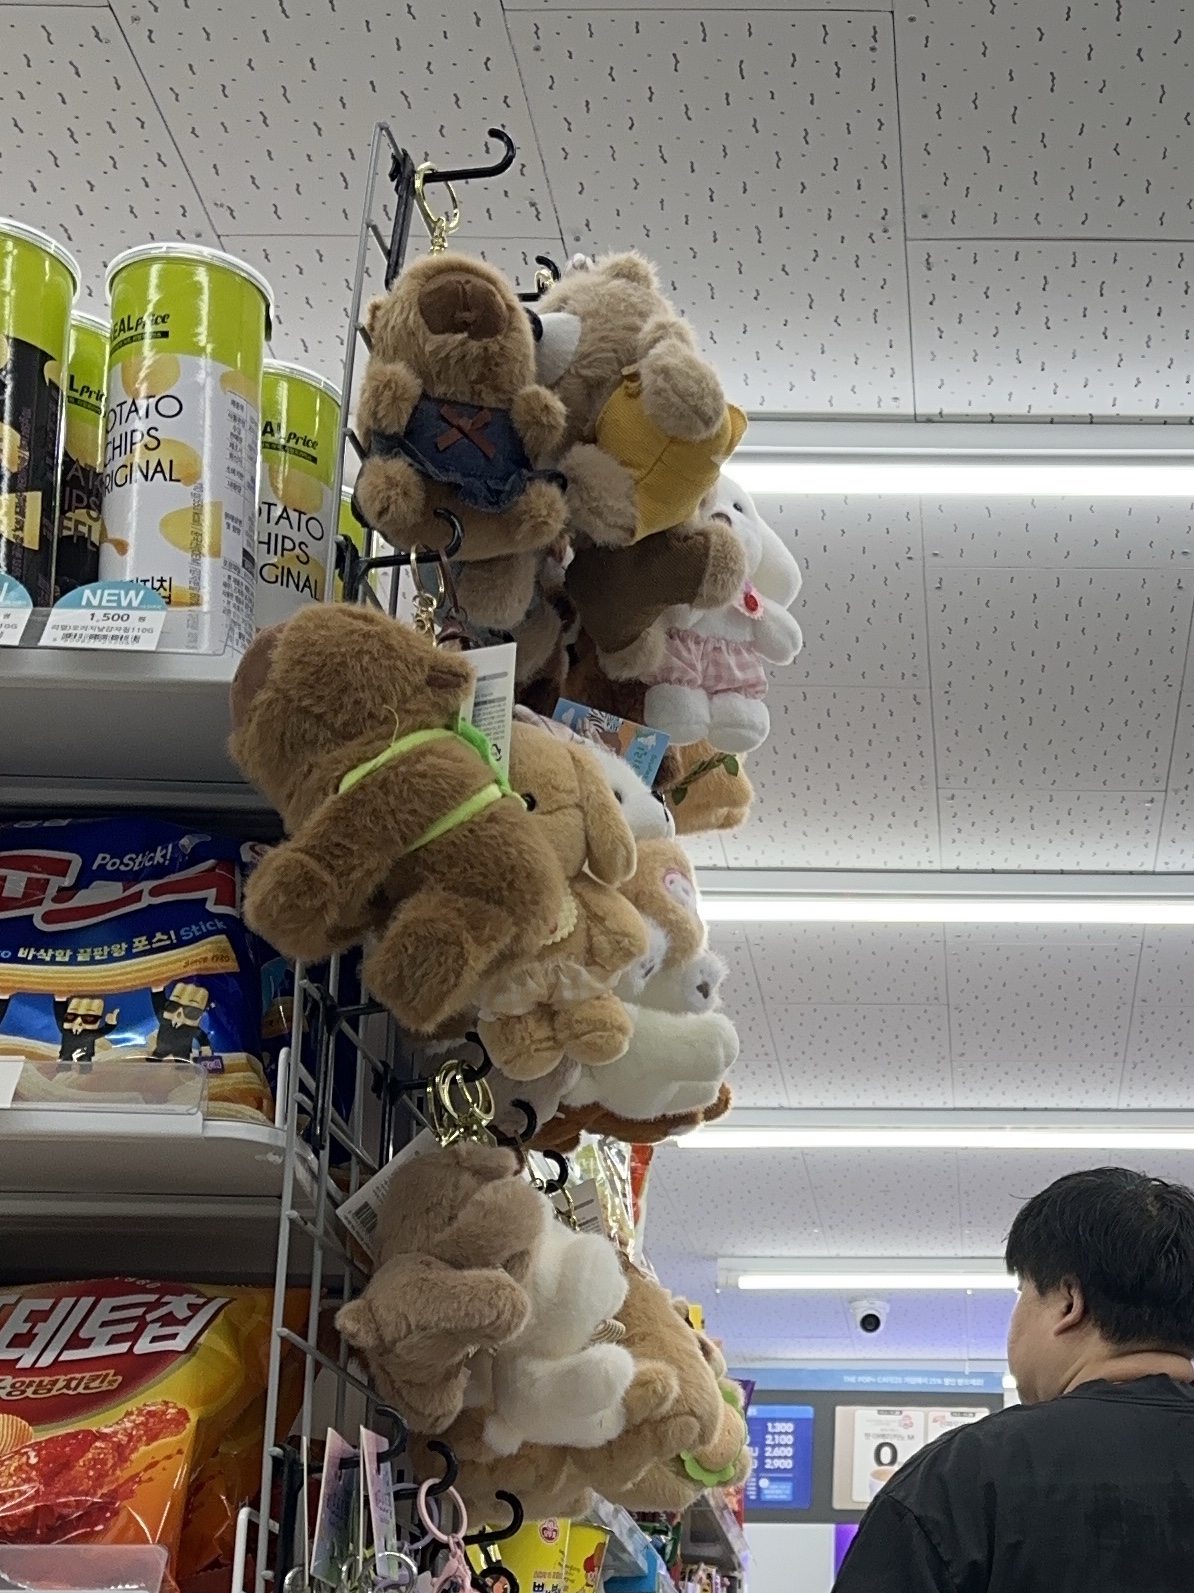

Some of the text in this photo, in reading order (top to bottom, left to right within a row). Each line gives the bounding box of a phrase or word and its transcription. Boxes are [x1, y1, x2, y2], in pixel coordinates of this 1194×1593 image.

[106, 394, 183, 434] OTATO
[104, 458, 181, 497] RIGINAL
[258, 500, 324, 541] TATO
[258, 532, 310, 566] HIPS
[81, 589, 145, 607] NEW
[259, 562, 324, 601] GINAL
[90, 612, 130, 623] 1,500
[93, 844, 173, 872] PoStick!
[180, 919, 227, 941] Stick
[0, 1293, 237, 1369] 테토칩
